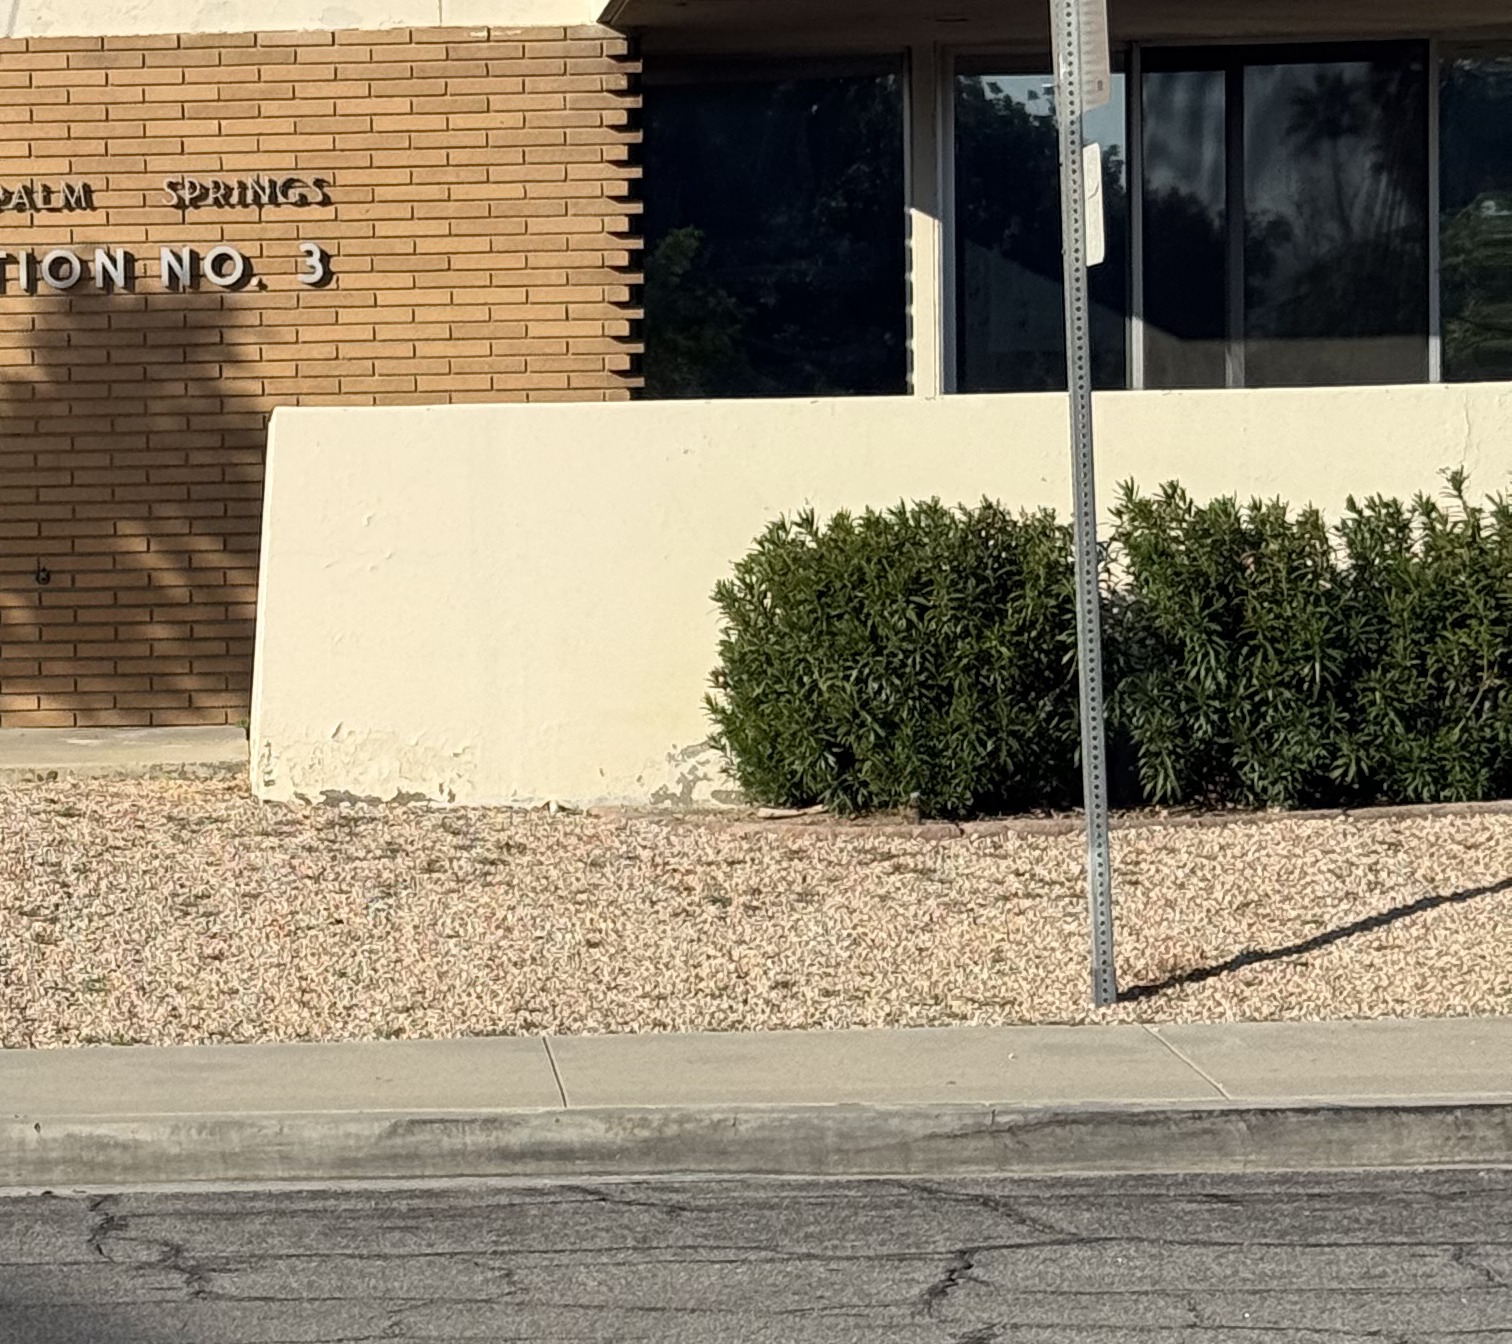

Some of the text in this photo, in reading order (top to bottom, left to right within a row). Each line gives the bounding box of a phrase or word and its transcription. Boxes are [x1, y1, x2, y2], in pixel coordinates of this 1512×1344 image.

[161, 177, 327, 205] SPRINGS
[160, 245, 259, 288] NO.
[297, 242, 325, 284] 3
